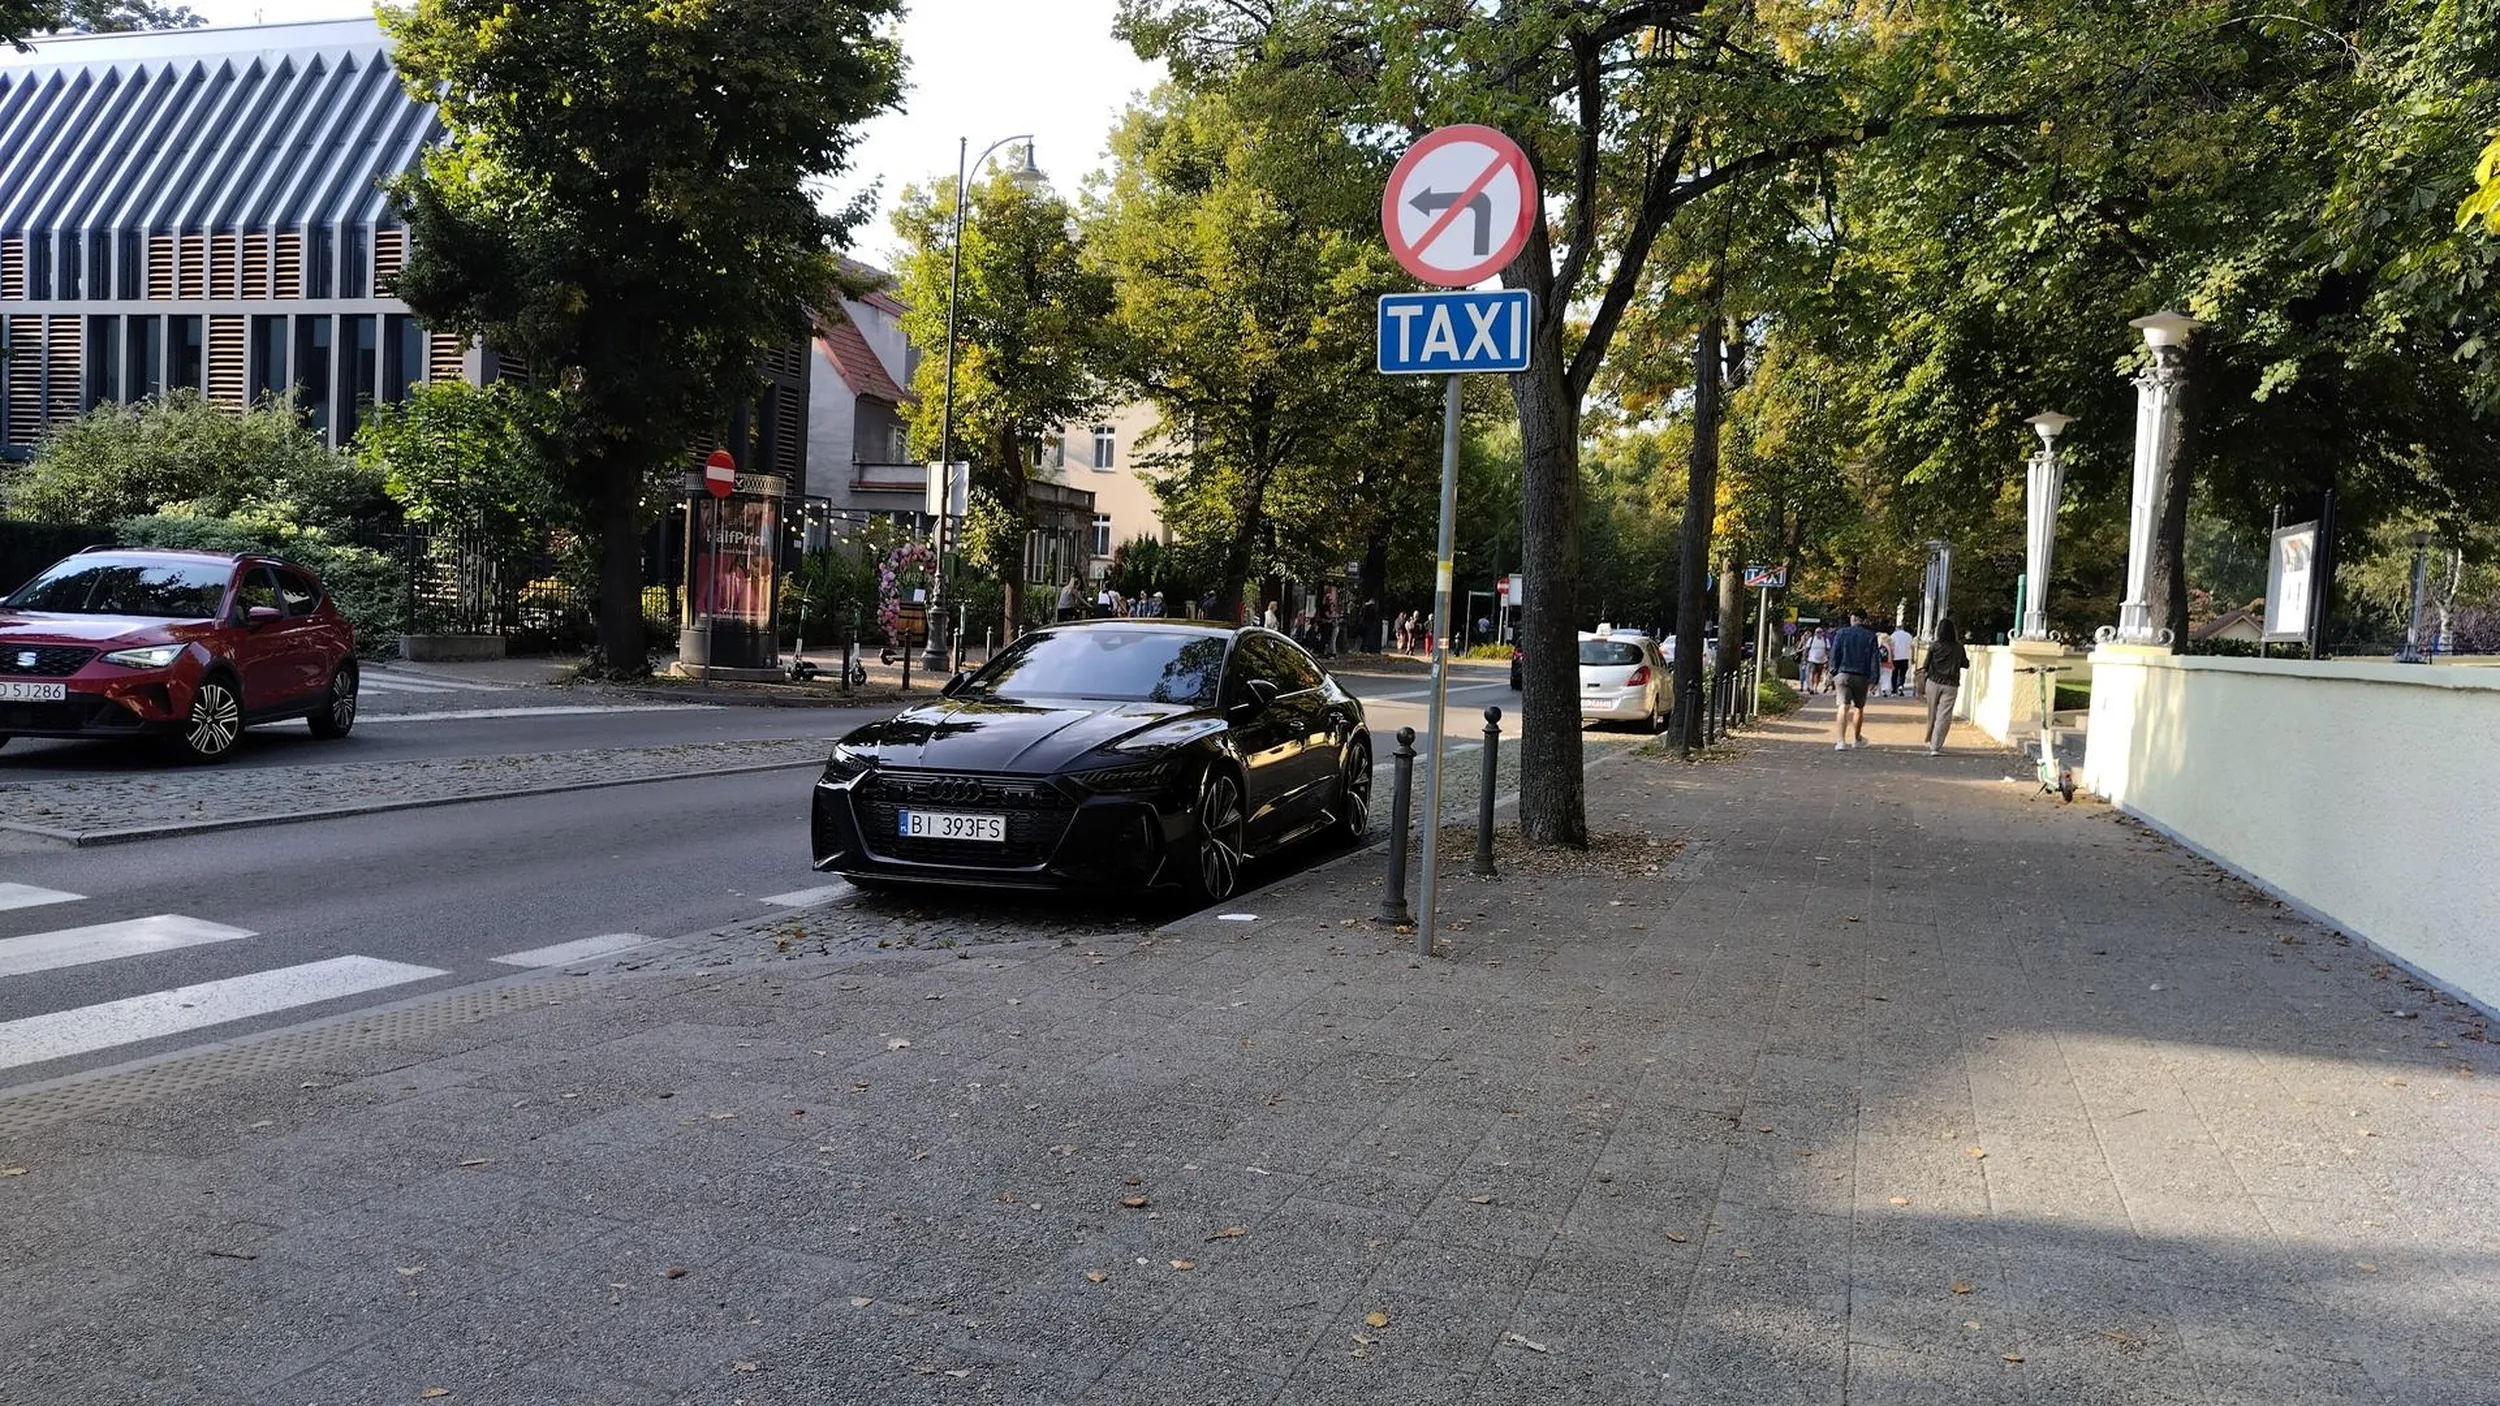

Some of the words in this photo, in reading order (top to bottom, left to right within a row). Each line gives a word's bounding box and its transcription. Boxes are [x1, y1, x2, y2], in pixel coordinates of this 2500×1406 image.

[1387, 301, 1522, 363] TAXI
[13, 684, 62, 699] 5J286
[911, 815, 931, 835] BI
[942, 817, 1000, 838] 393FS
